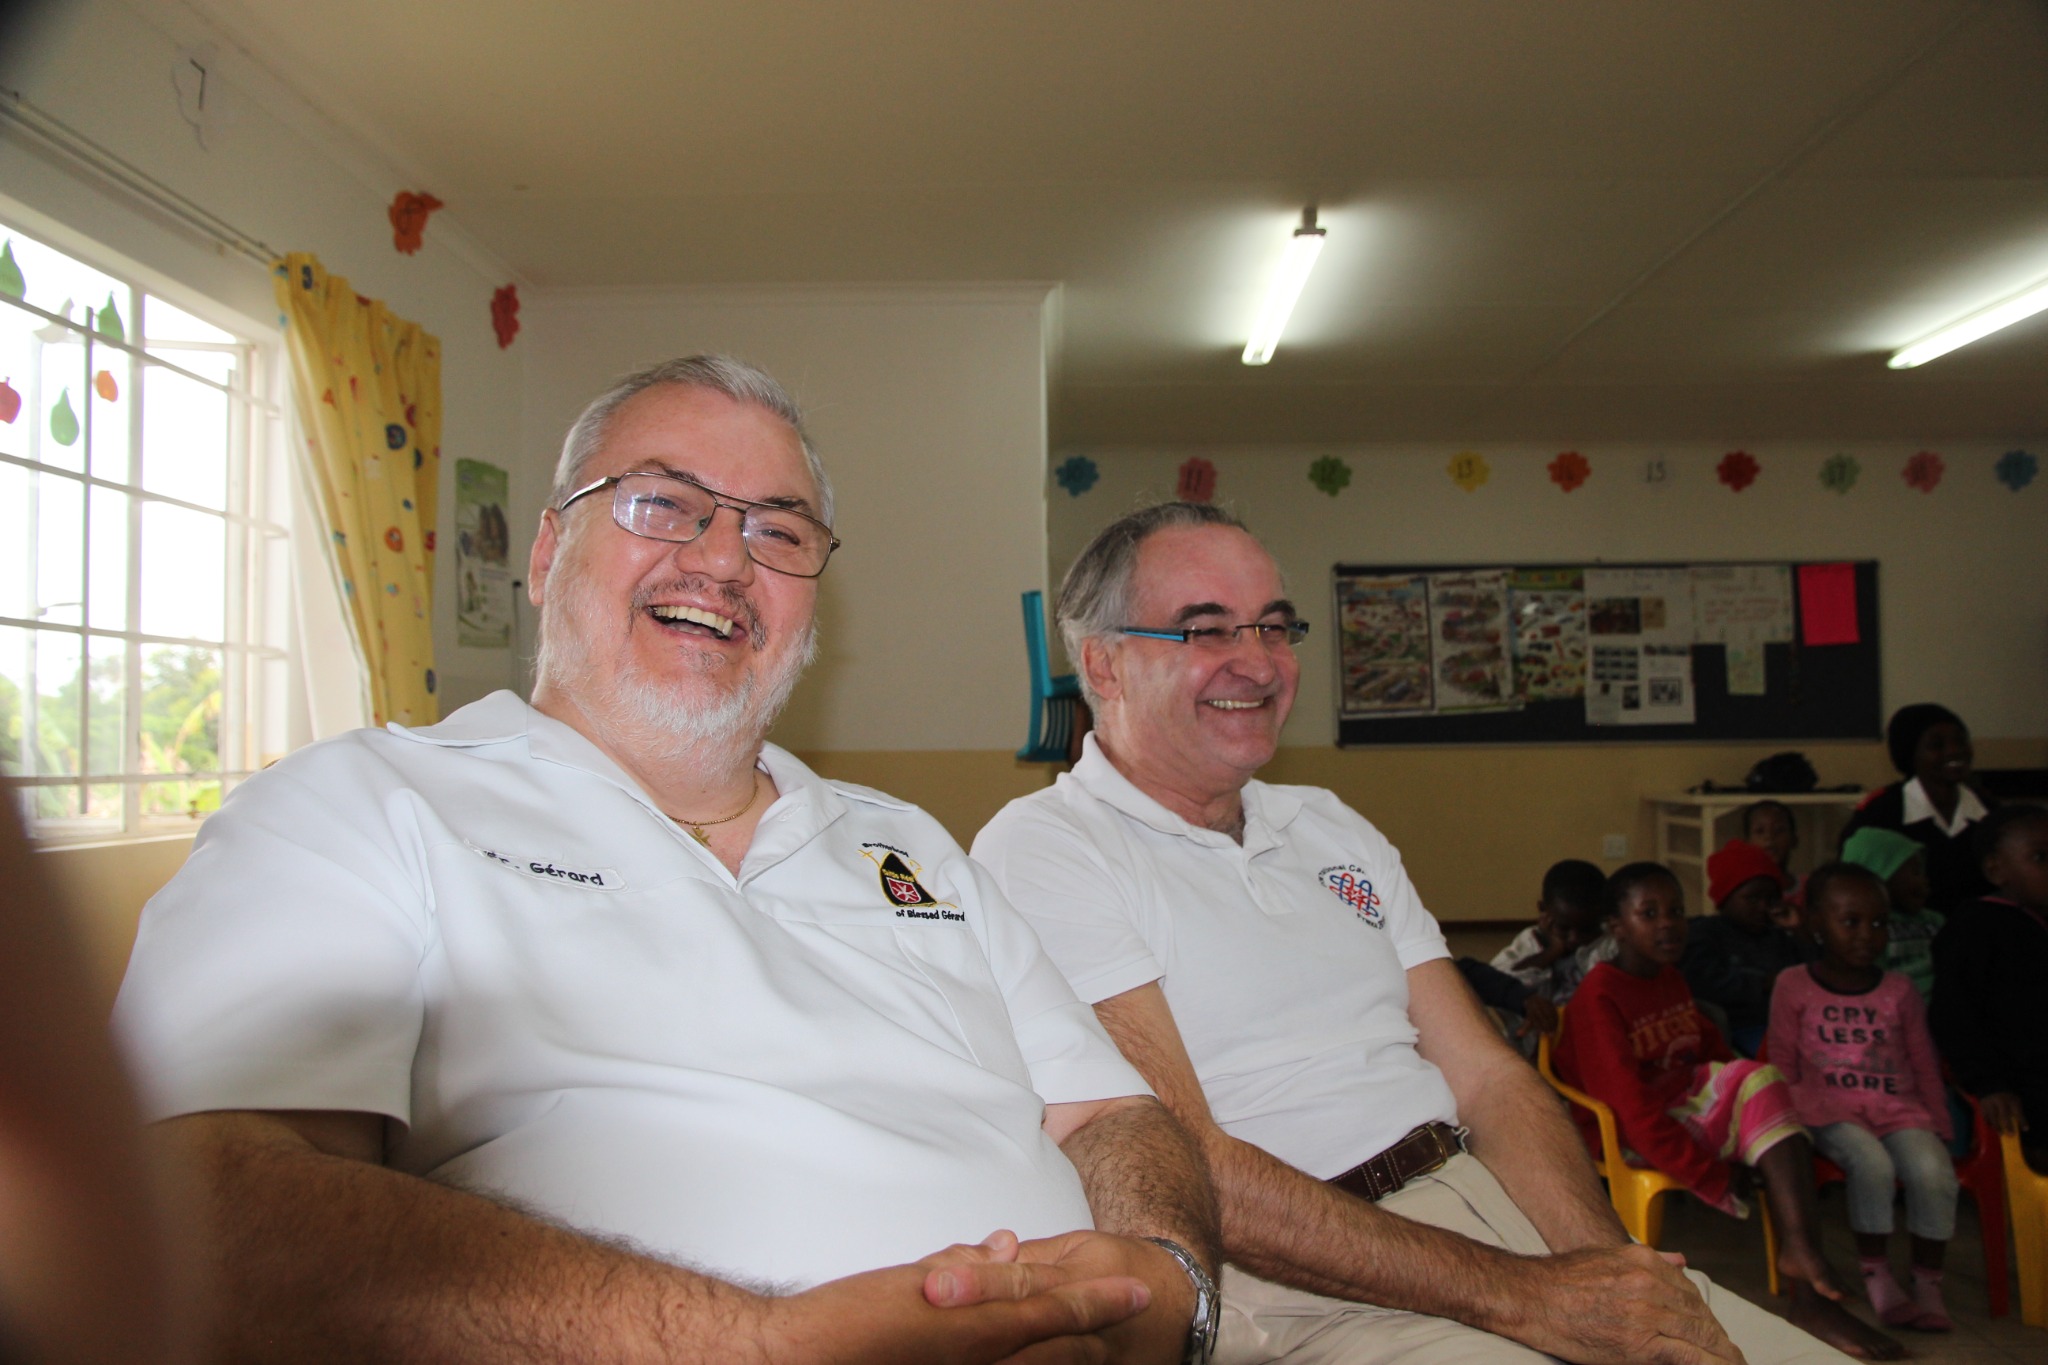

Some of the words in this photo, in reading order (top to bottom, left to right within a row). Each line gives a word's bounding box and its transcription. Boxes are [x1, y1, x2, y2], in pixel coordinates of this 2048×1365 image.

[1646, 460, 1667, 484] 15
[529, 862, 605, 886] Gérard
[896, 909, 905, 918] of
[906, 909, 940, 921] Blessed
[941, 909, 966, 922] Gérard
[1823, 1004, 1878, 1025] CRY
[1817, 1024, 1887, 1047] LESS
